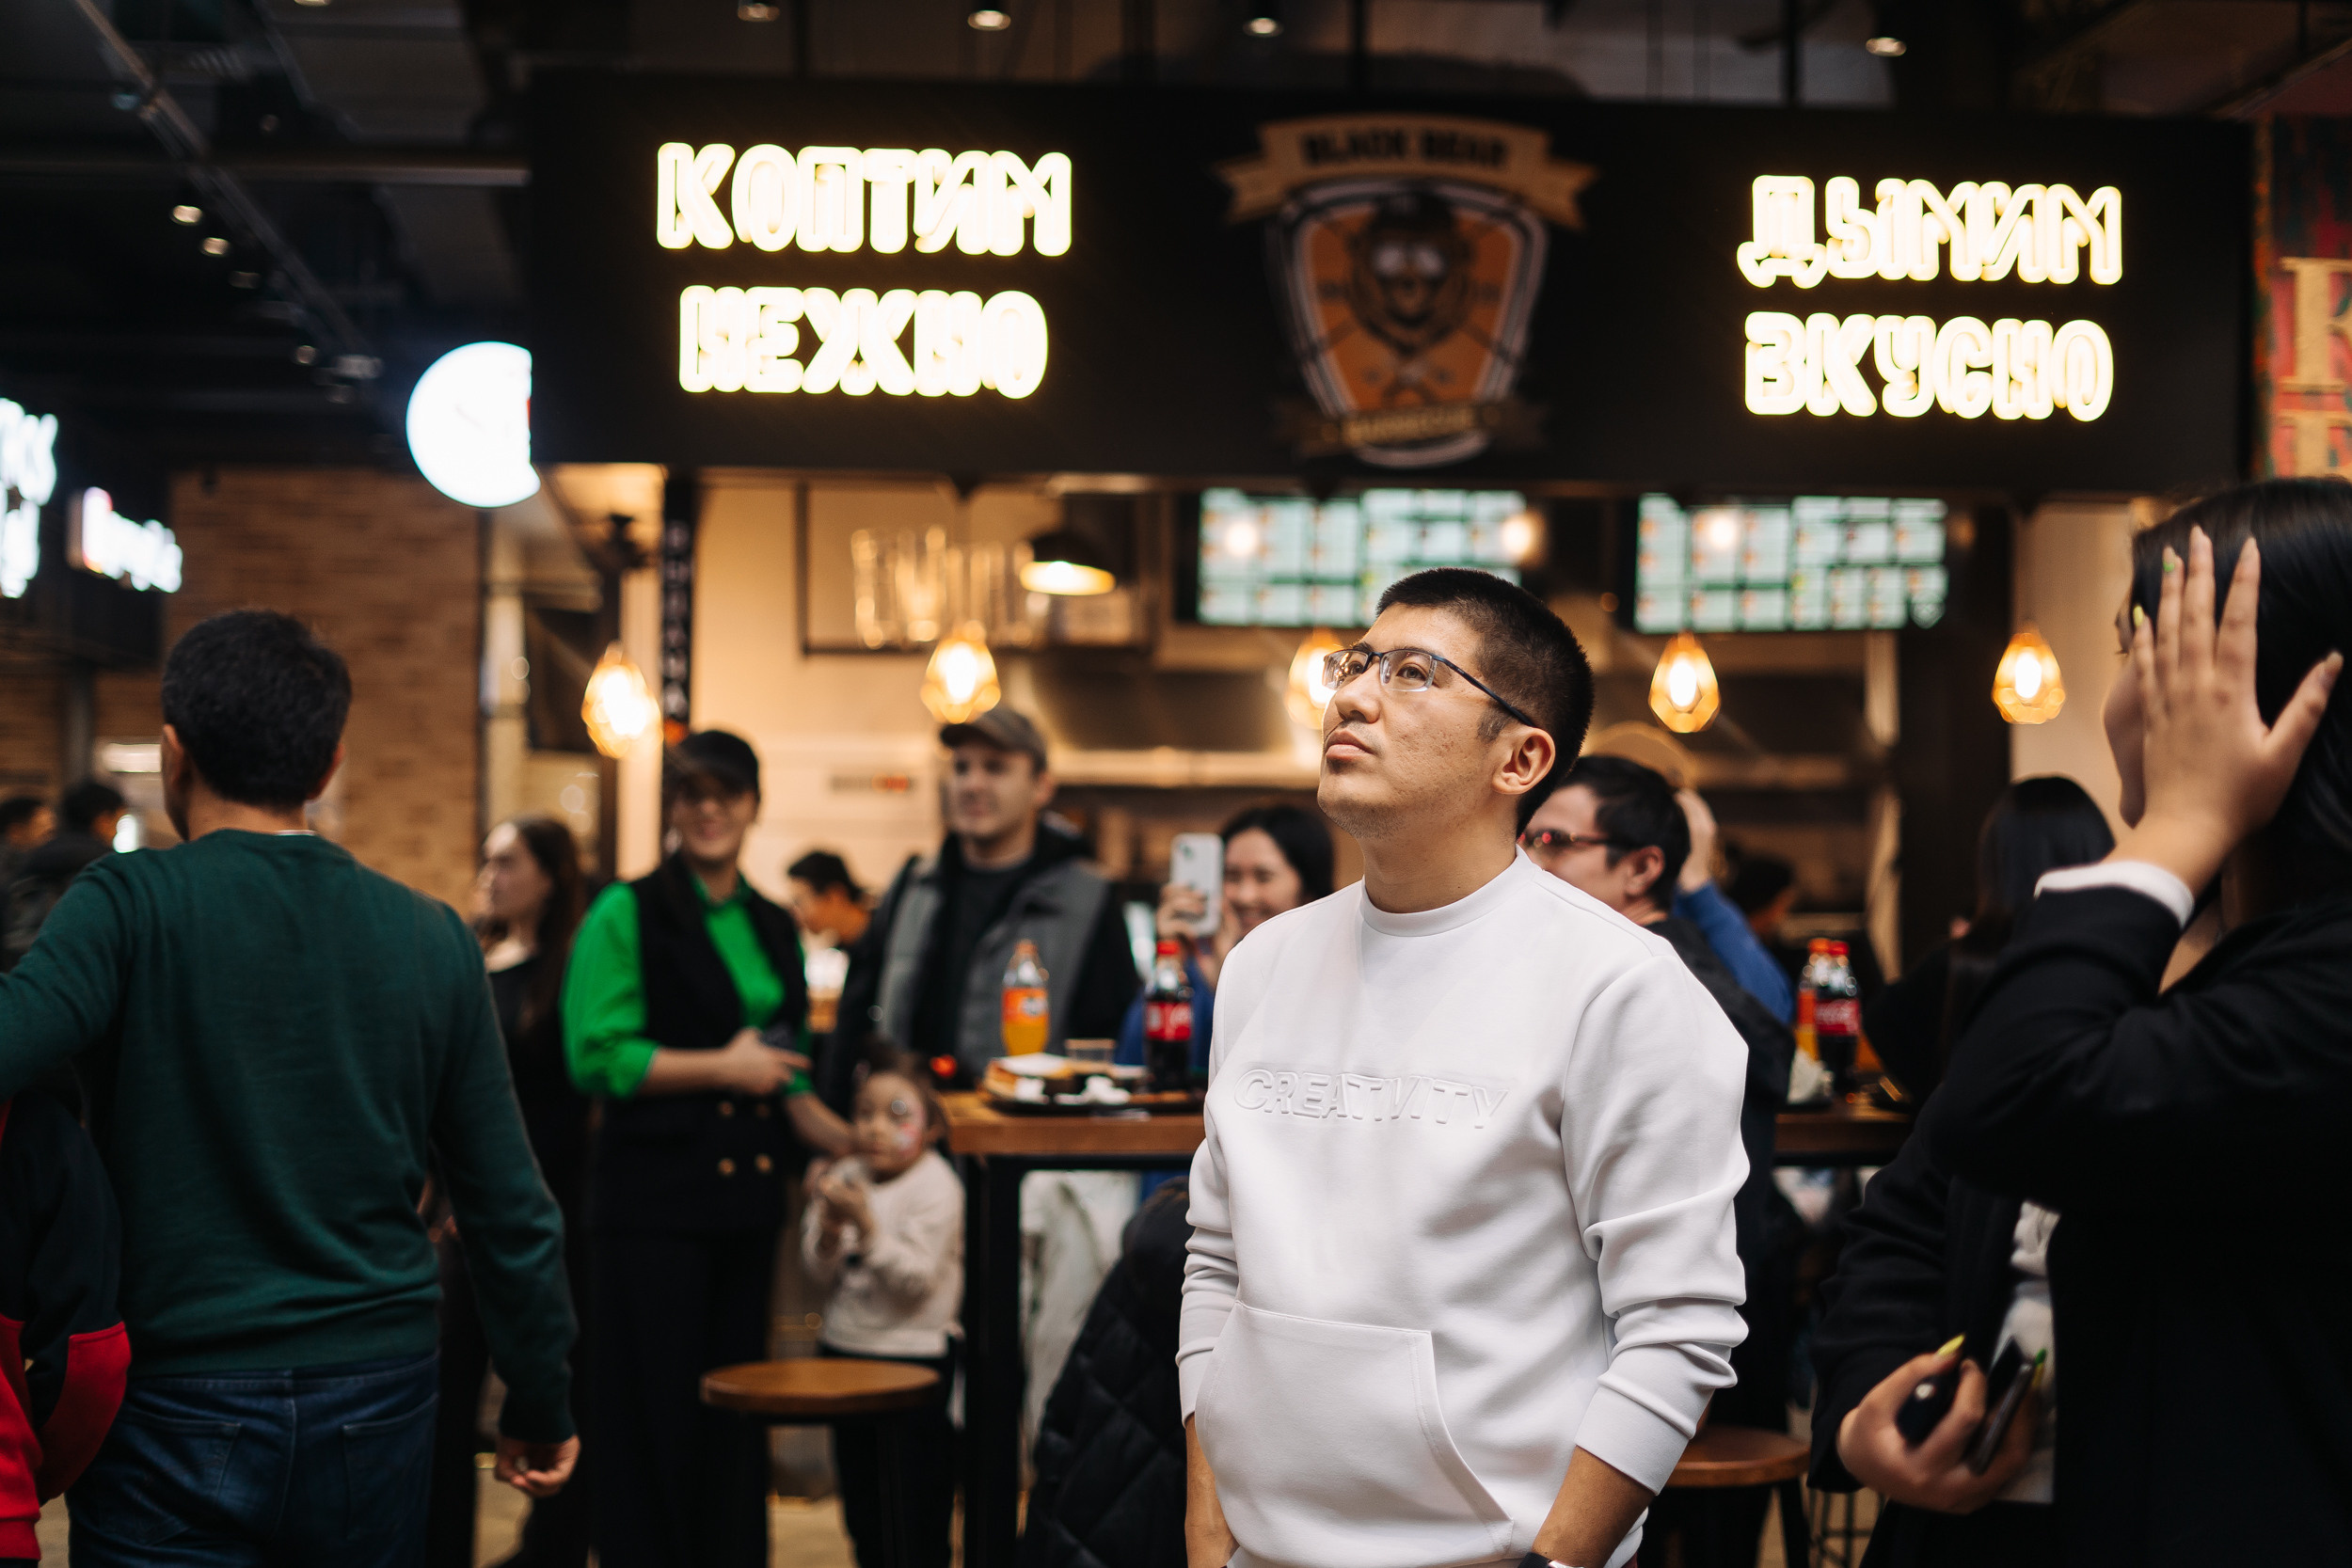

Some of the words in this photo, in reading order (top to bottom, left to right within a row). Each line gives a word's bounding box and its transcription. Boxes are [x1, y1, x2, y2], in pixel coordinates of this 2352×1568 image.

[657, 142, 1072, 257] КОПТИМ
[1737, 175, 2122, 289] ДЫМИМ
[679, 285, 1049, 399] НЕЖНО
[1745, 311, 2114, 421] ВКУСНО
[1233, 1069, 1510, 1130] CREATIVITY
